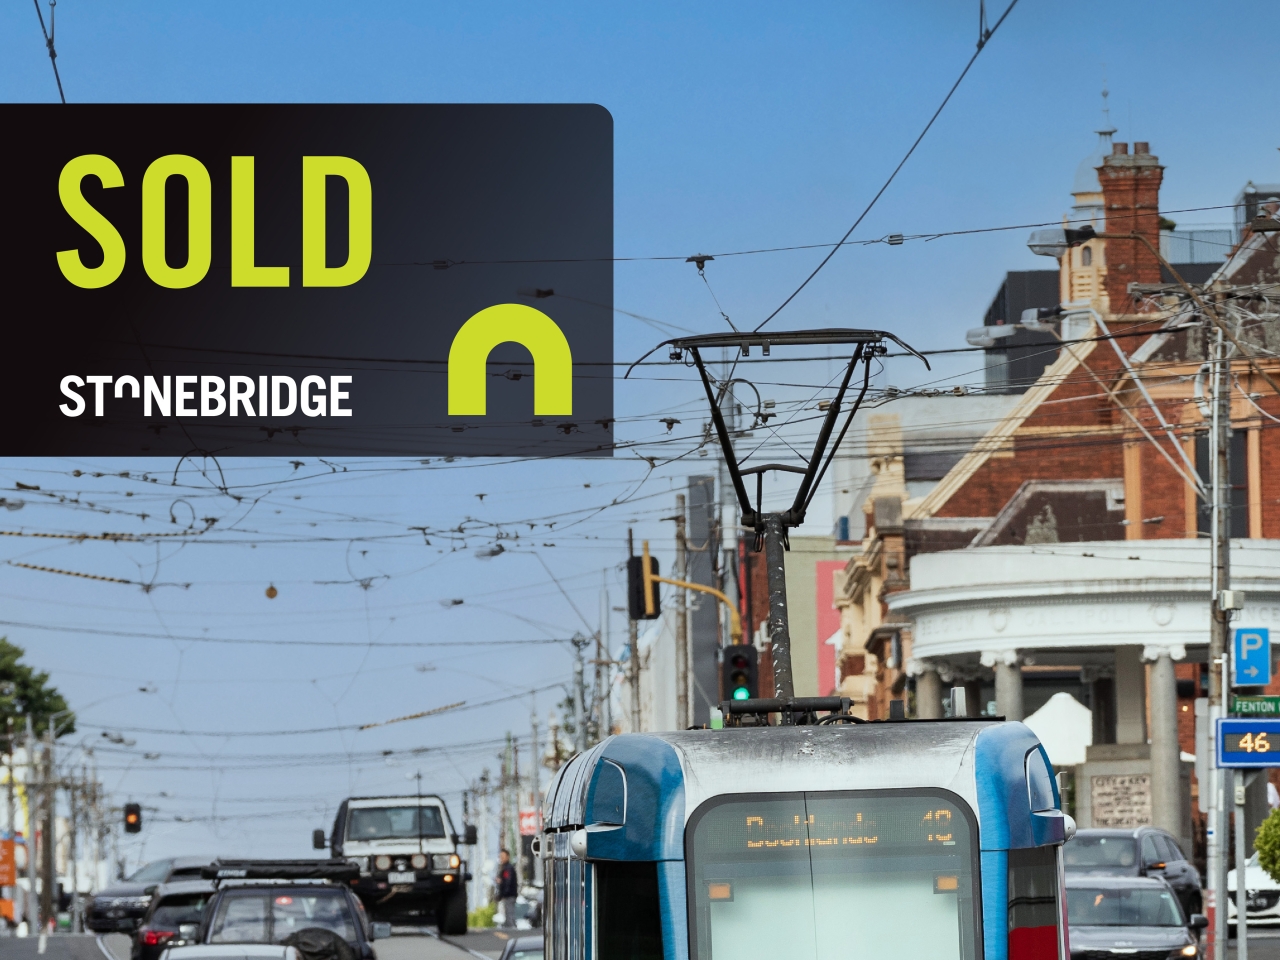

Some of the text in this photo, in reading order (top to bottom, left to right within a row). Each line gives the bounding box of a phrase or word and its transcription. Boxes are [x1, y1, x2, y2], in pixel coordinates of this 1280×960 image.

[1241, 633, 1263, 660] P
[1235, 701, 1276, 713] FENTON
[1238, 732, 1271, 753] 46
